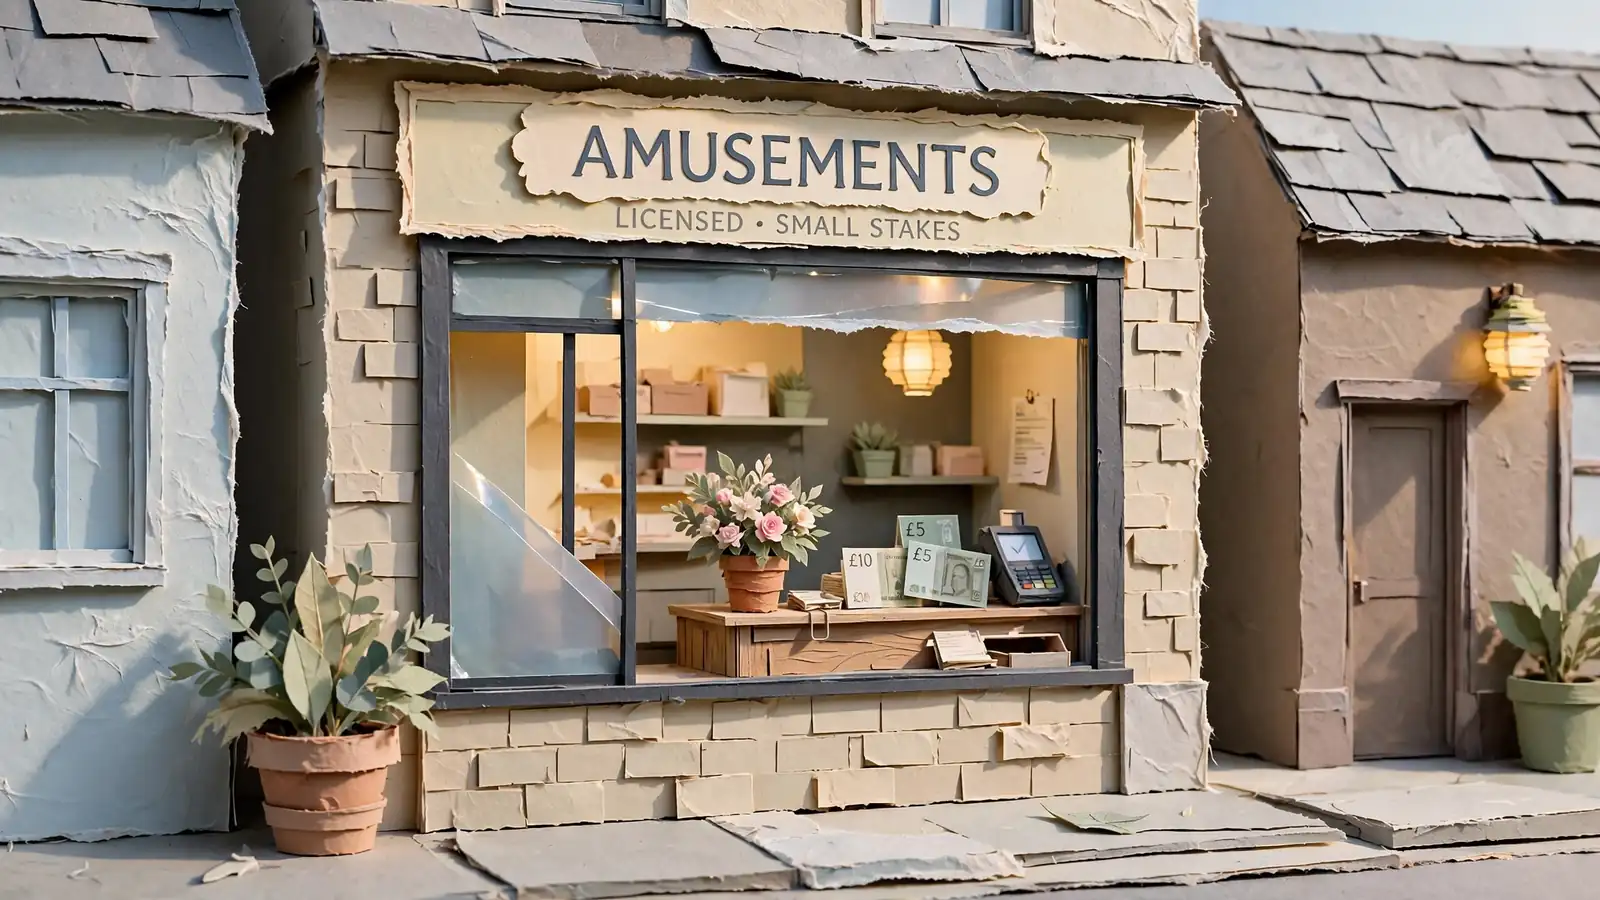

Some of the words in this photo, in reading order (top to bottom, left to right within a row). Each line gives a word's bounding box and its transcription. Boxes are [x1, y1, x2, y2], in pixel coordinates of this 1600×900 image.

[572, 125, 1000, 197] AMUSEMENTS
[615, 206, 744, 233] LICENSED
[776, 213, 860, 238] SMALL
[870, 218, 961, 241] STAKES
[906, 522, 926, 537] £5
[849, 553, 872, 567] £10
[912, 547, 932, 562] £5
